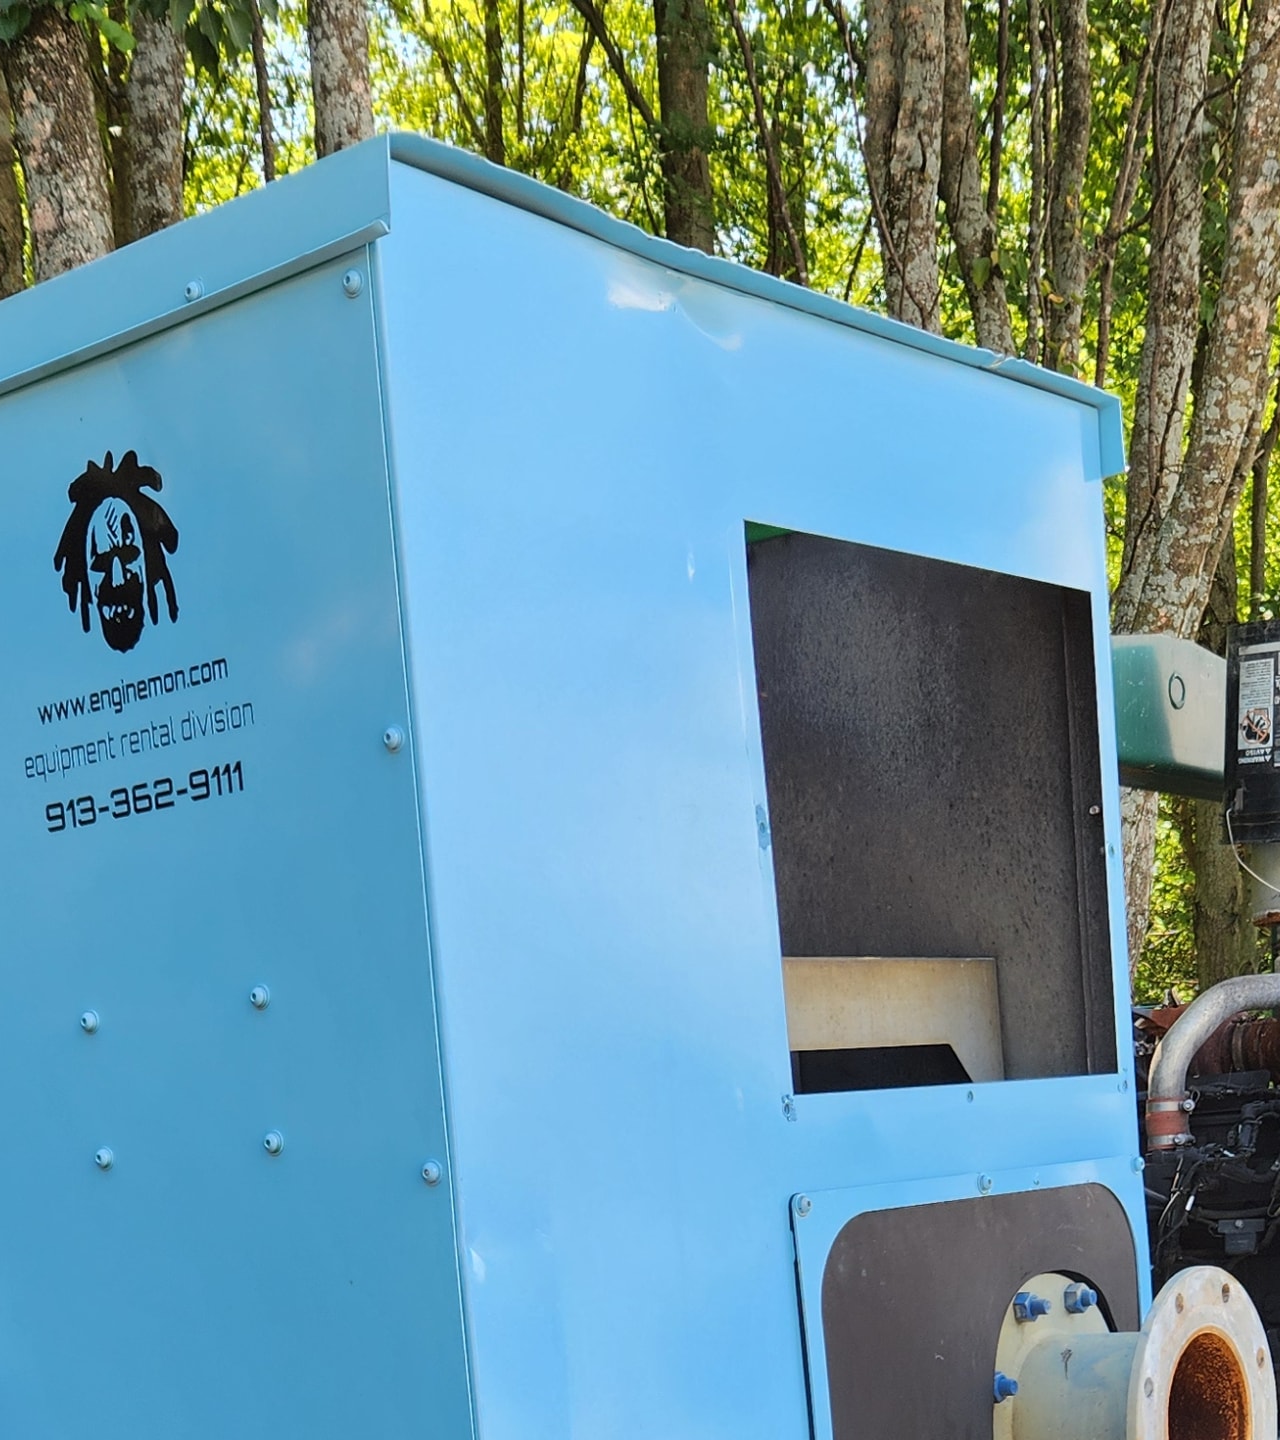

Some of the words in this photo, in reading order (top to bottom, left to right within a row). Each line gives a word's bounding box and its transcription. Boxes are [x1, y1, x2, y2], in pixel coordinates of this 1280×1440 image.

[37, 658, 229, 725] www.enginemon.com
[24, 731, 116, 782] equipment
[120, 716, 177, 757] rental
[181, 701, 255, 742] division
[45, 760, 245, 833] 913-362-9111
